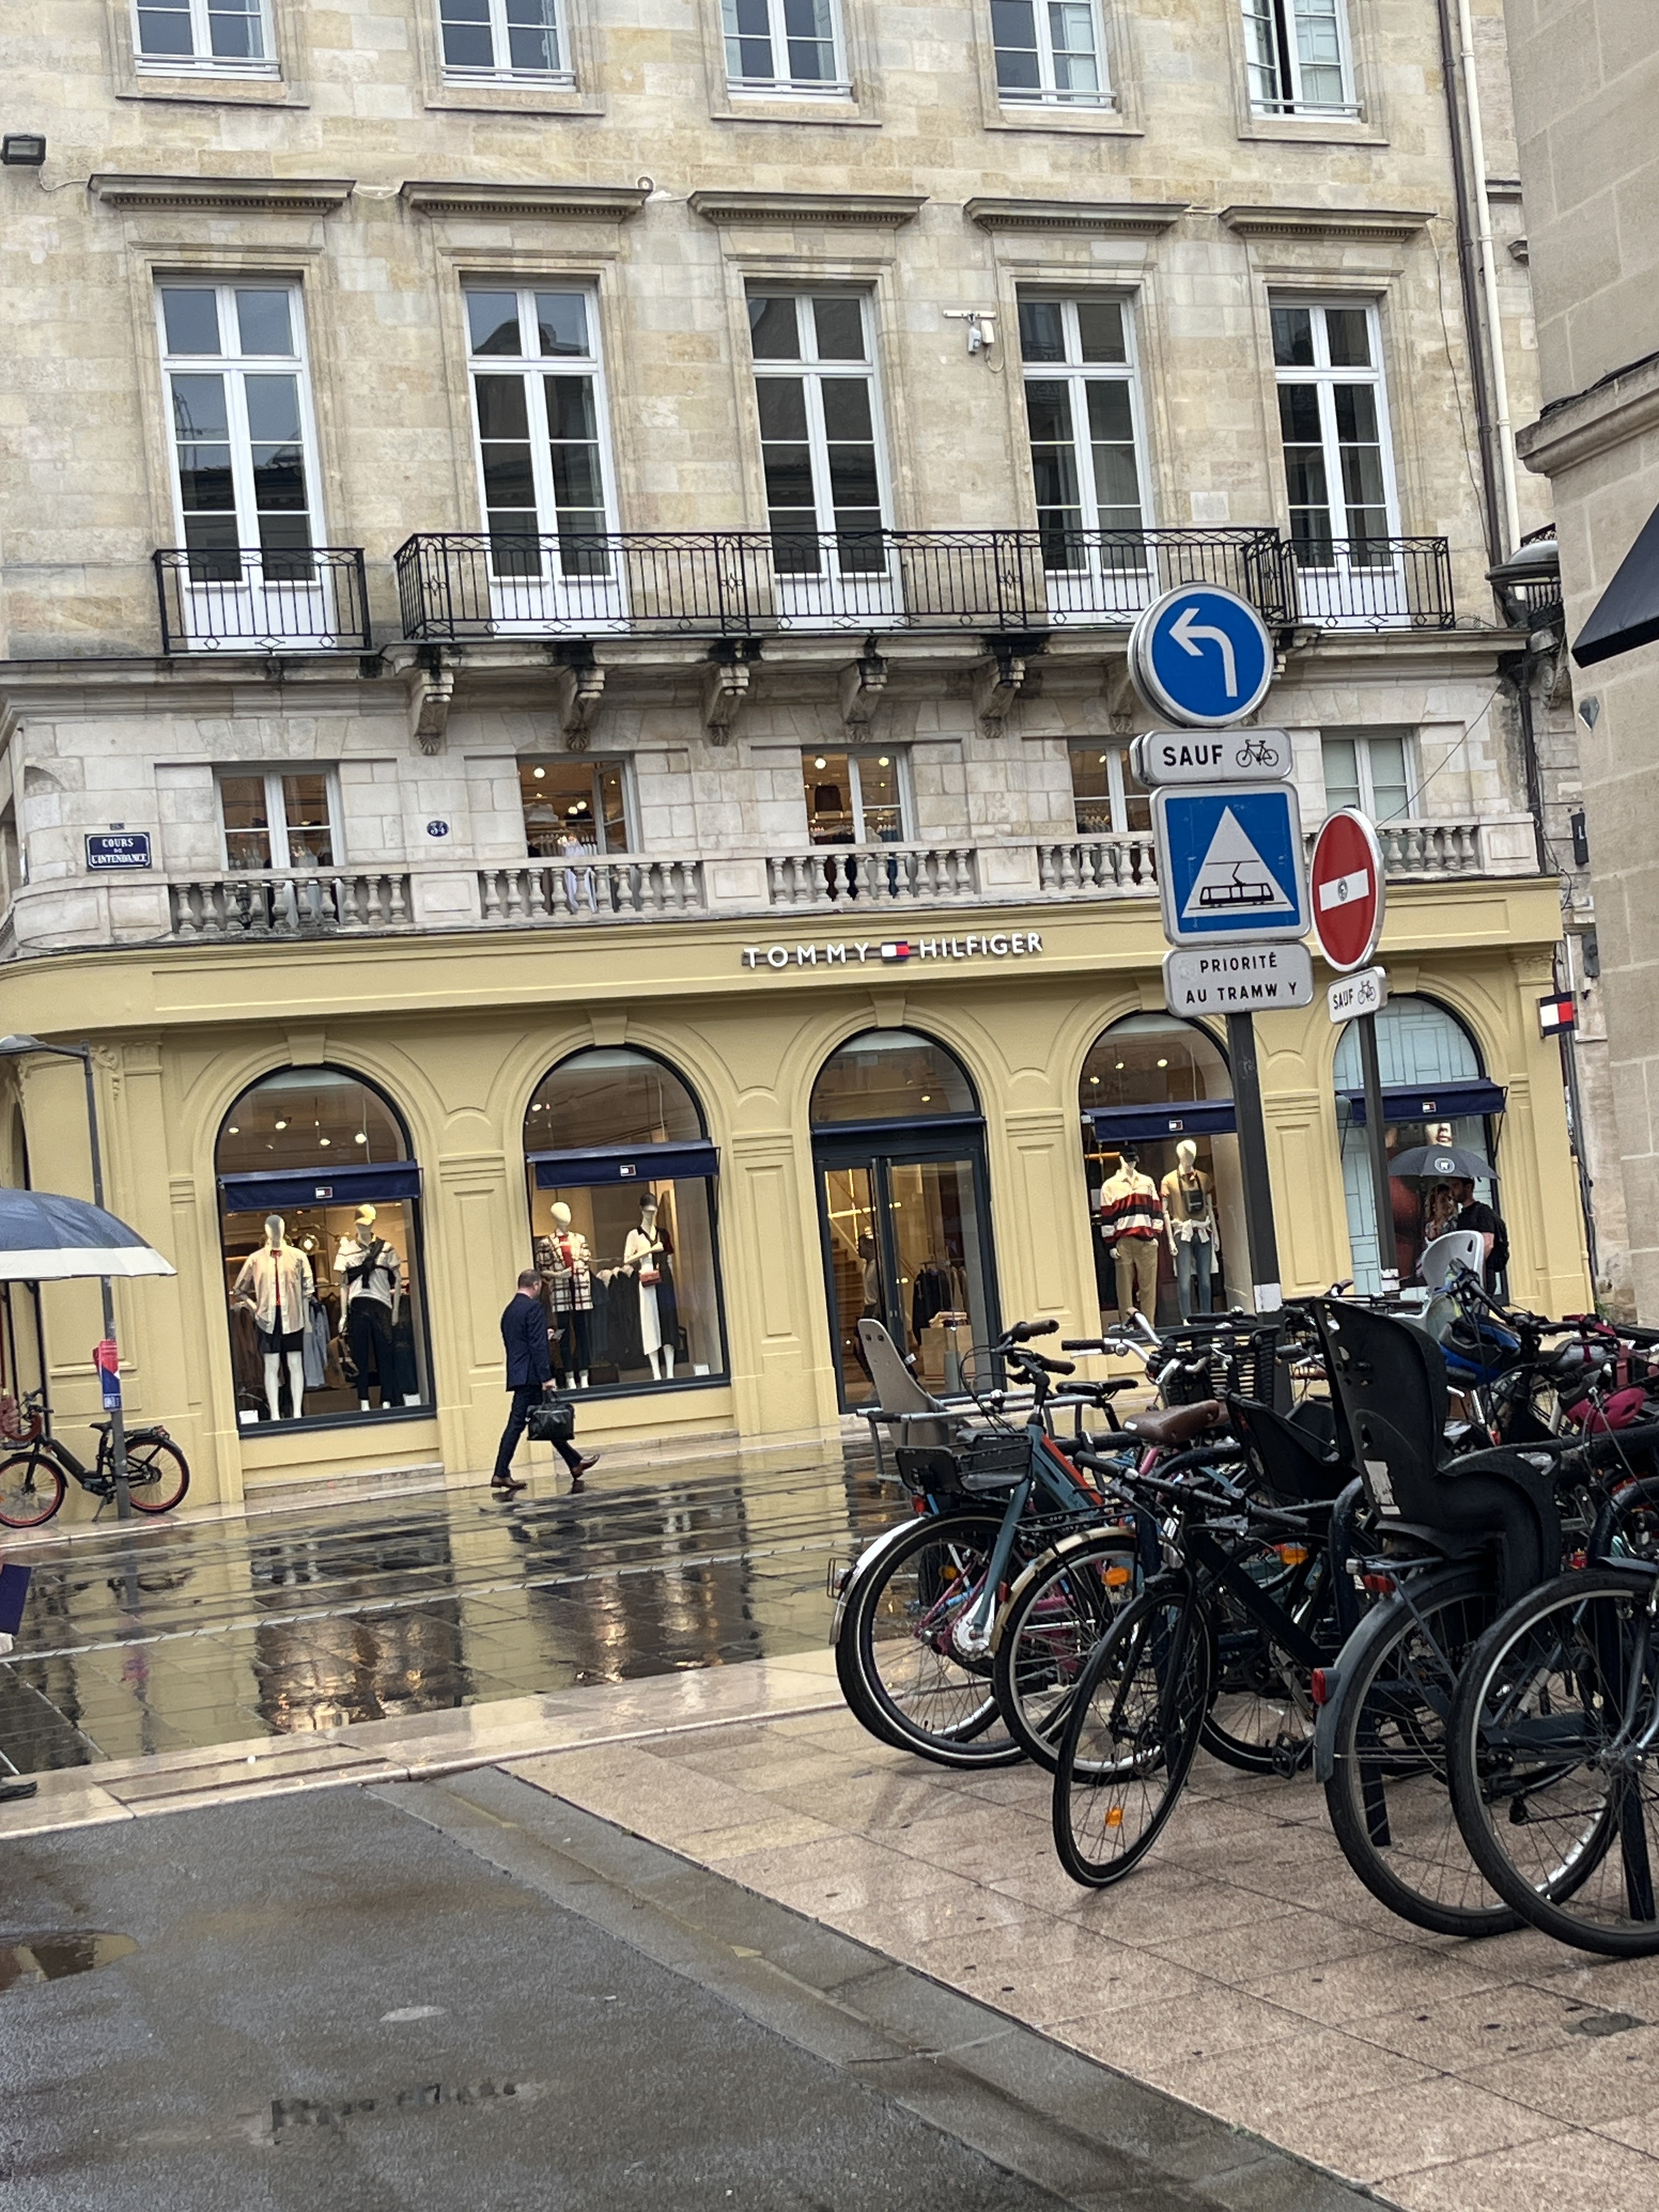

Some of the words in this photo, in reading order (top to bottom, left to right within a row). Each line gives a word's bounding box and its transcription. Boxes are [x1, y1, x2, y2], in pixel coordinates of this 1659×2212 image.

[1163, 744, 1223, 766] SAUF
[102, 838, 134, 848] COURS
[743, 941, 870, 969] TOMMY
[919, 932, 1043, 959] HILFIGER
[1200, 952, 1278, 973] PRIORITÉ
[1186, 989, 1207, 1004] AU
[1217, 981, 1297, 1001] TRAMWY
[1333, 988, 1353, 1010] SAUF
